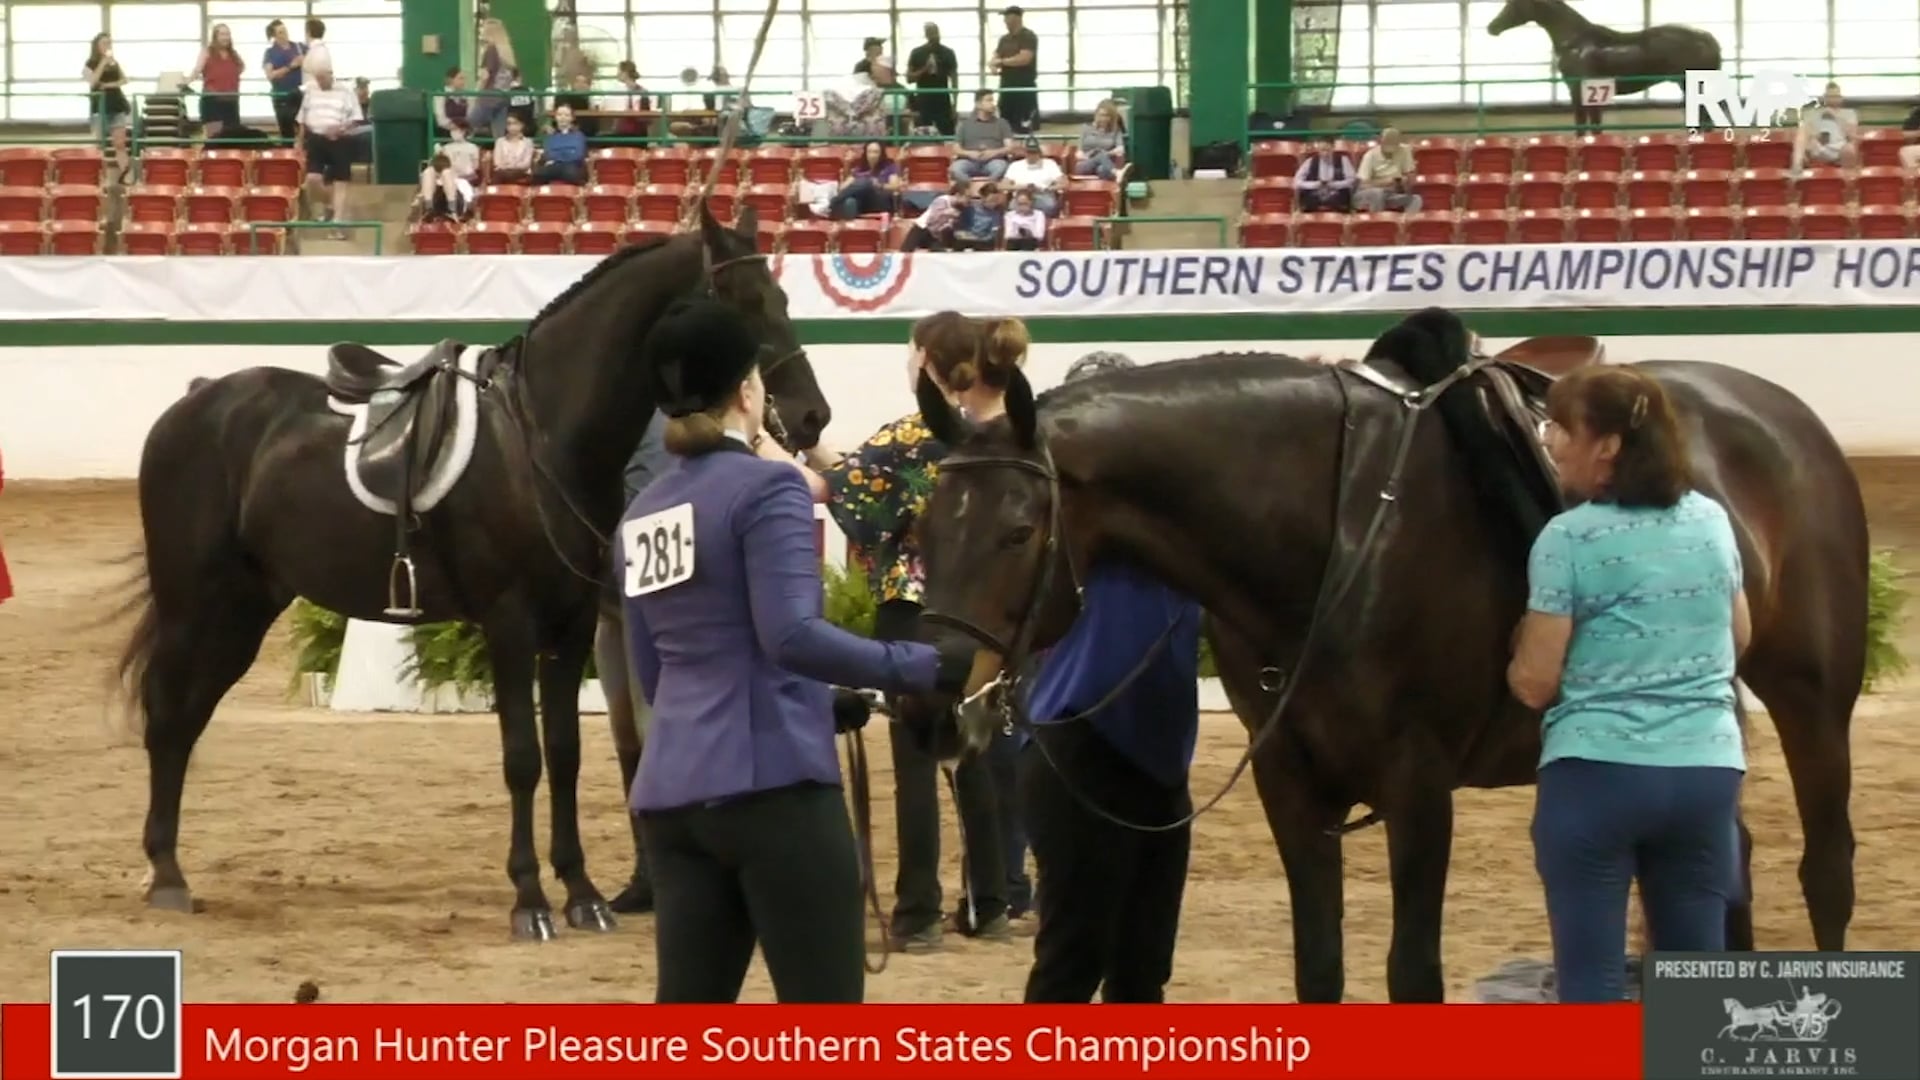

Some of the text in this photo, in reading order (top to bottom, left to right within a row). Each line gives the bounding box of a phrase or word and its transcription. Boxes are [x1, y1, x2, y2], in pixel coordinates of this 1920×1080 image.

[797, 97, 821, 116] 25
[1586, 85, 1611, 103] 27
[1014, 255, 1263, 298] SOUTHERN
[1277, 252, 1446, 294] STATES
[1457, 247, 1815, 292] CHAMPIONSHIP
[636, 522, 685, 589] 281
